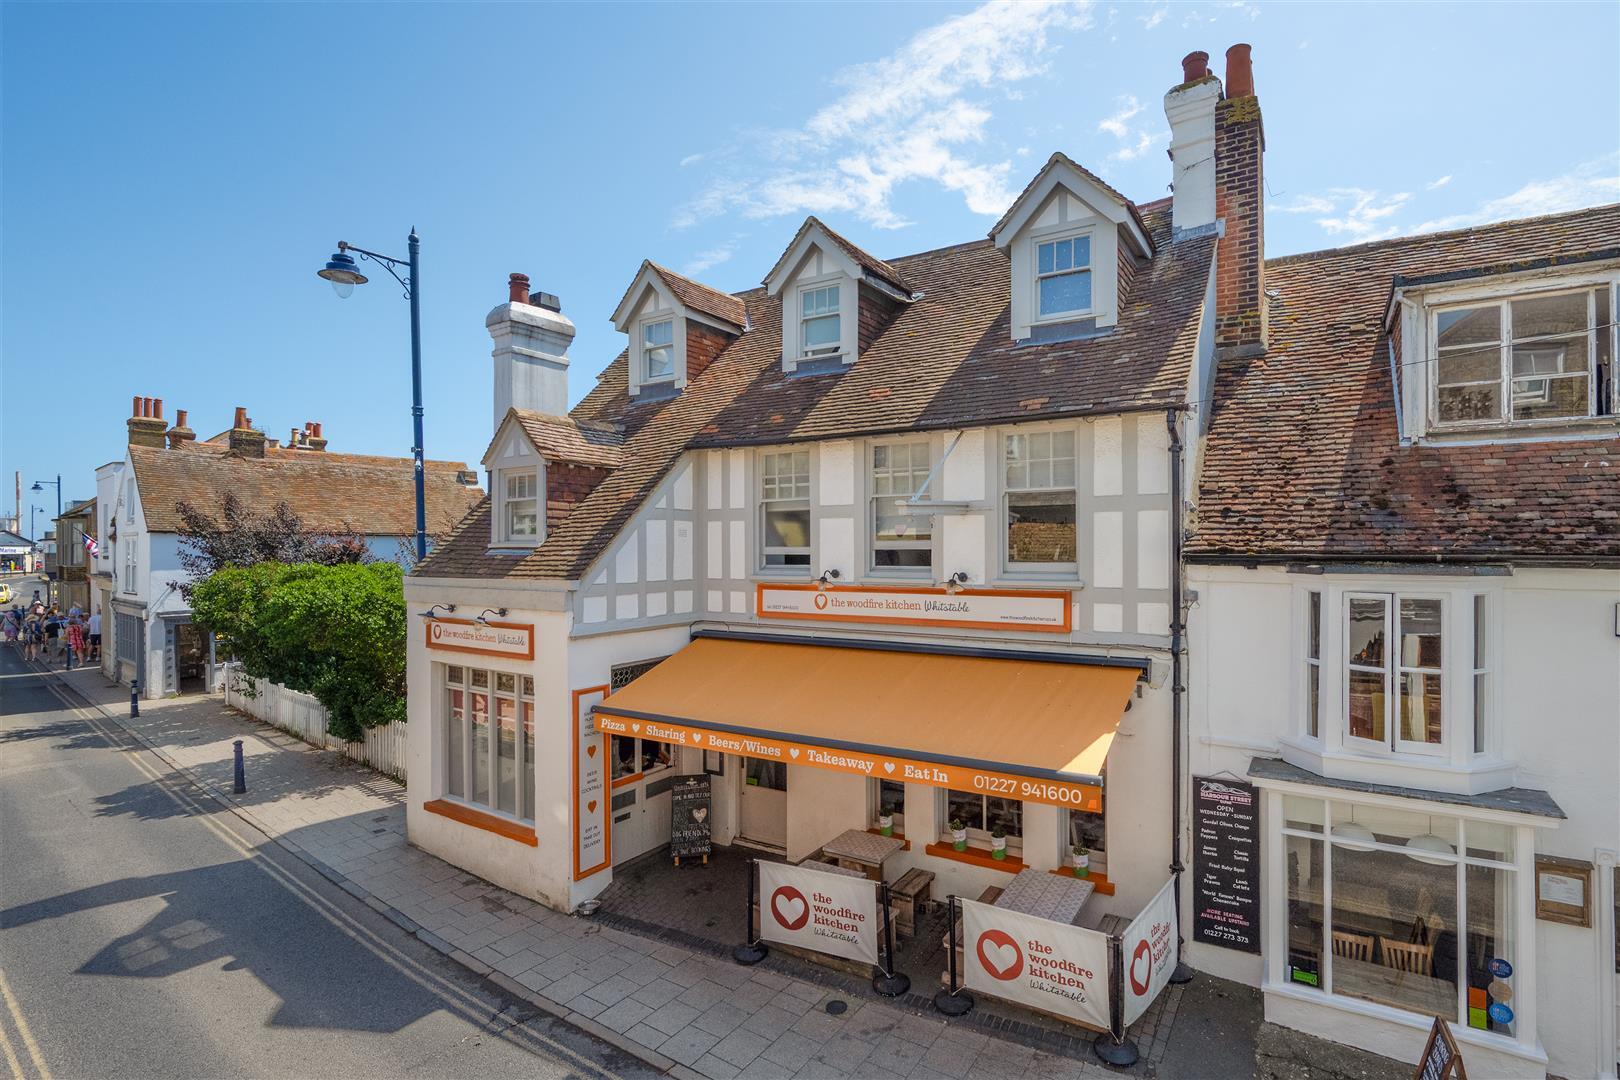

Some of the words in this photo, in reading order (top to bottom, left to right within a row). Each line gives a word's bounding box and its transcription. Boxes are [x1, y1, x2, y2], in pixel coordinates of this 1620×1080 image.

[831, 597, 845, 607] the
[847, 599, 884, 609] woodfire
[885, 600, 921, 610] kitchen
[924, 600, 970, 612] Whitstable
[443, 628, 452, 638] the
[452, 631, 474, 640] woodfire
[475, 632, 496, 642] kitchen
[497, 633, 526, 646] Whitstable
[601, 718, 626, 732] Pizza
[646, 725, 686, 743] Sharing
[709, 735, 782, 757] Beers/Wines
[808, 749, 875, 773] Takeaway
[904, 764, 930, 780] Eat
[933, 768, 949, 783] In
[974, 775, 1018, 793] 01227
[1021, 782, 1082, 804] 941600
[1200, 791, 1230, 800] HARBOUR
[1230, 795, 1252, 804] STREET
[1200, 808, 1230, 817] WEDNESDAY
[583, 839, 601, 849] DELIVERY
[813, 892, 833, 904] the
[813, 905, 865, 922] woodfire
[1200, 912, 1227, 922] AVAILABLE
[1223, 911, 1244, 920] SEATING
[813, 914, 859, 932] kitchen
[1151, 922, 1160, 938] the
[813, 927, 859, 944] Whitstable
[1203, 928, 1223, 937] 01227
[1223, 932, 1236, 941] 273
[1236, 935, 1250, 944] 373
[1028, 940, 1053, 954] the
[1028, 953, 1094, 979] woodfire
[1029, 964, 1086, 991] kitchen
[1030, 979, 1087, 1003] Whitstable
